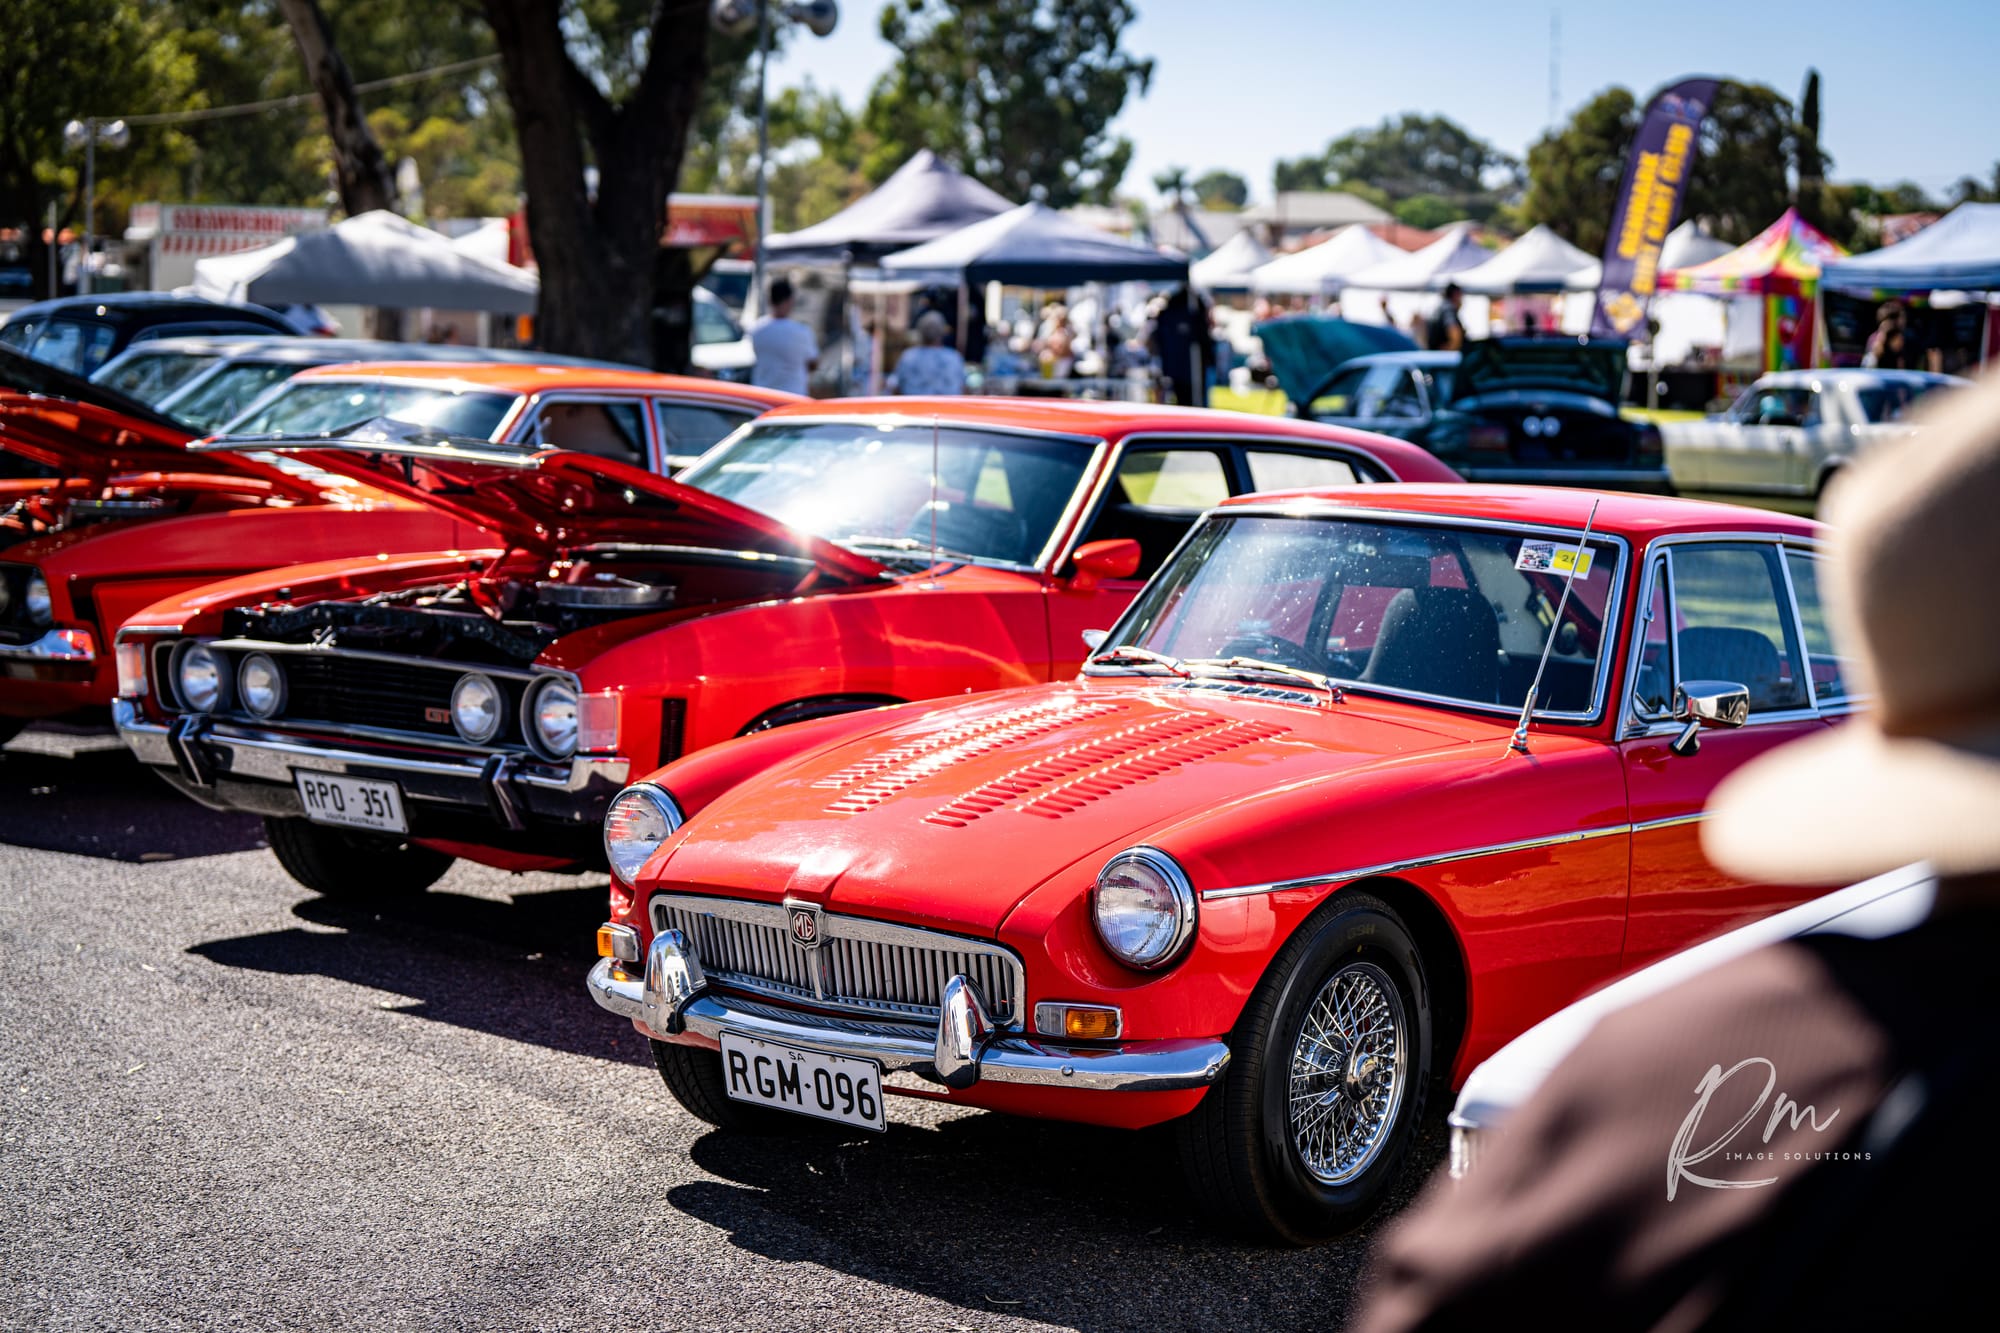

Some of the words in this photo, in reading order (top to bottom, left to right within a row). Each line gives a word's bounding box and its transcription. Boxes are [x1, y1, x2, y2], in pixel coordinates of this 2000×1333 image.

[1658, 123, 1693, 183] CLUB
[425, 707, 451, 723] GT
[795, 913, 813, 938] MG
[788, 1051, 806, 1063] SA
